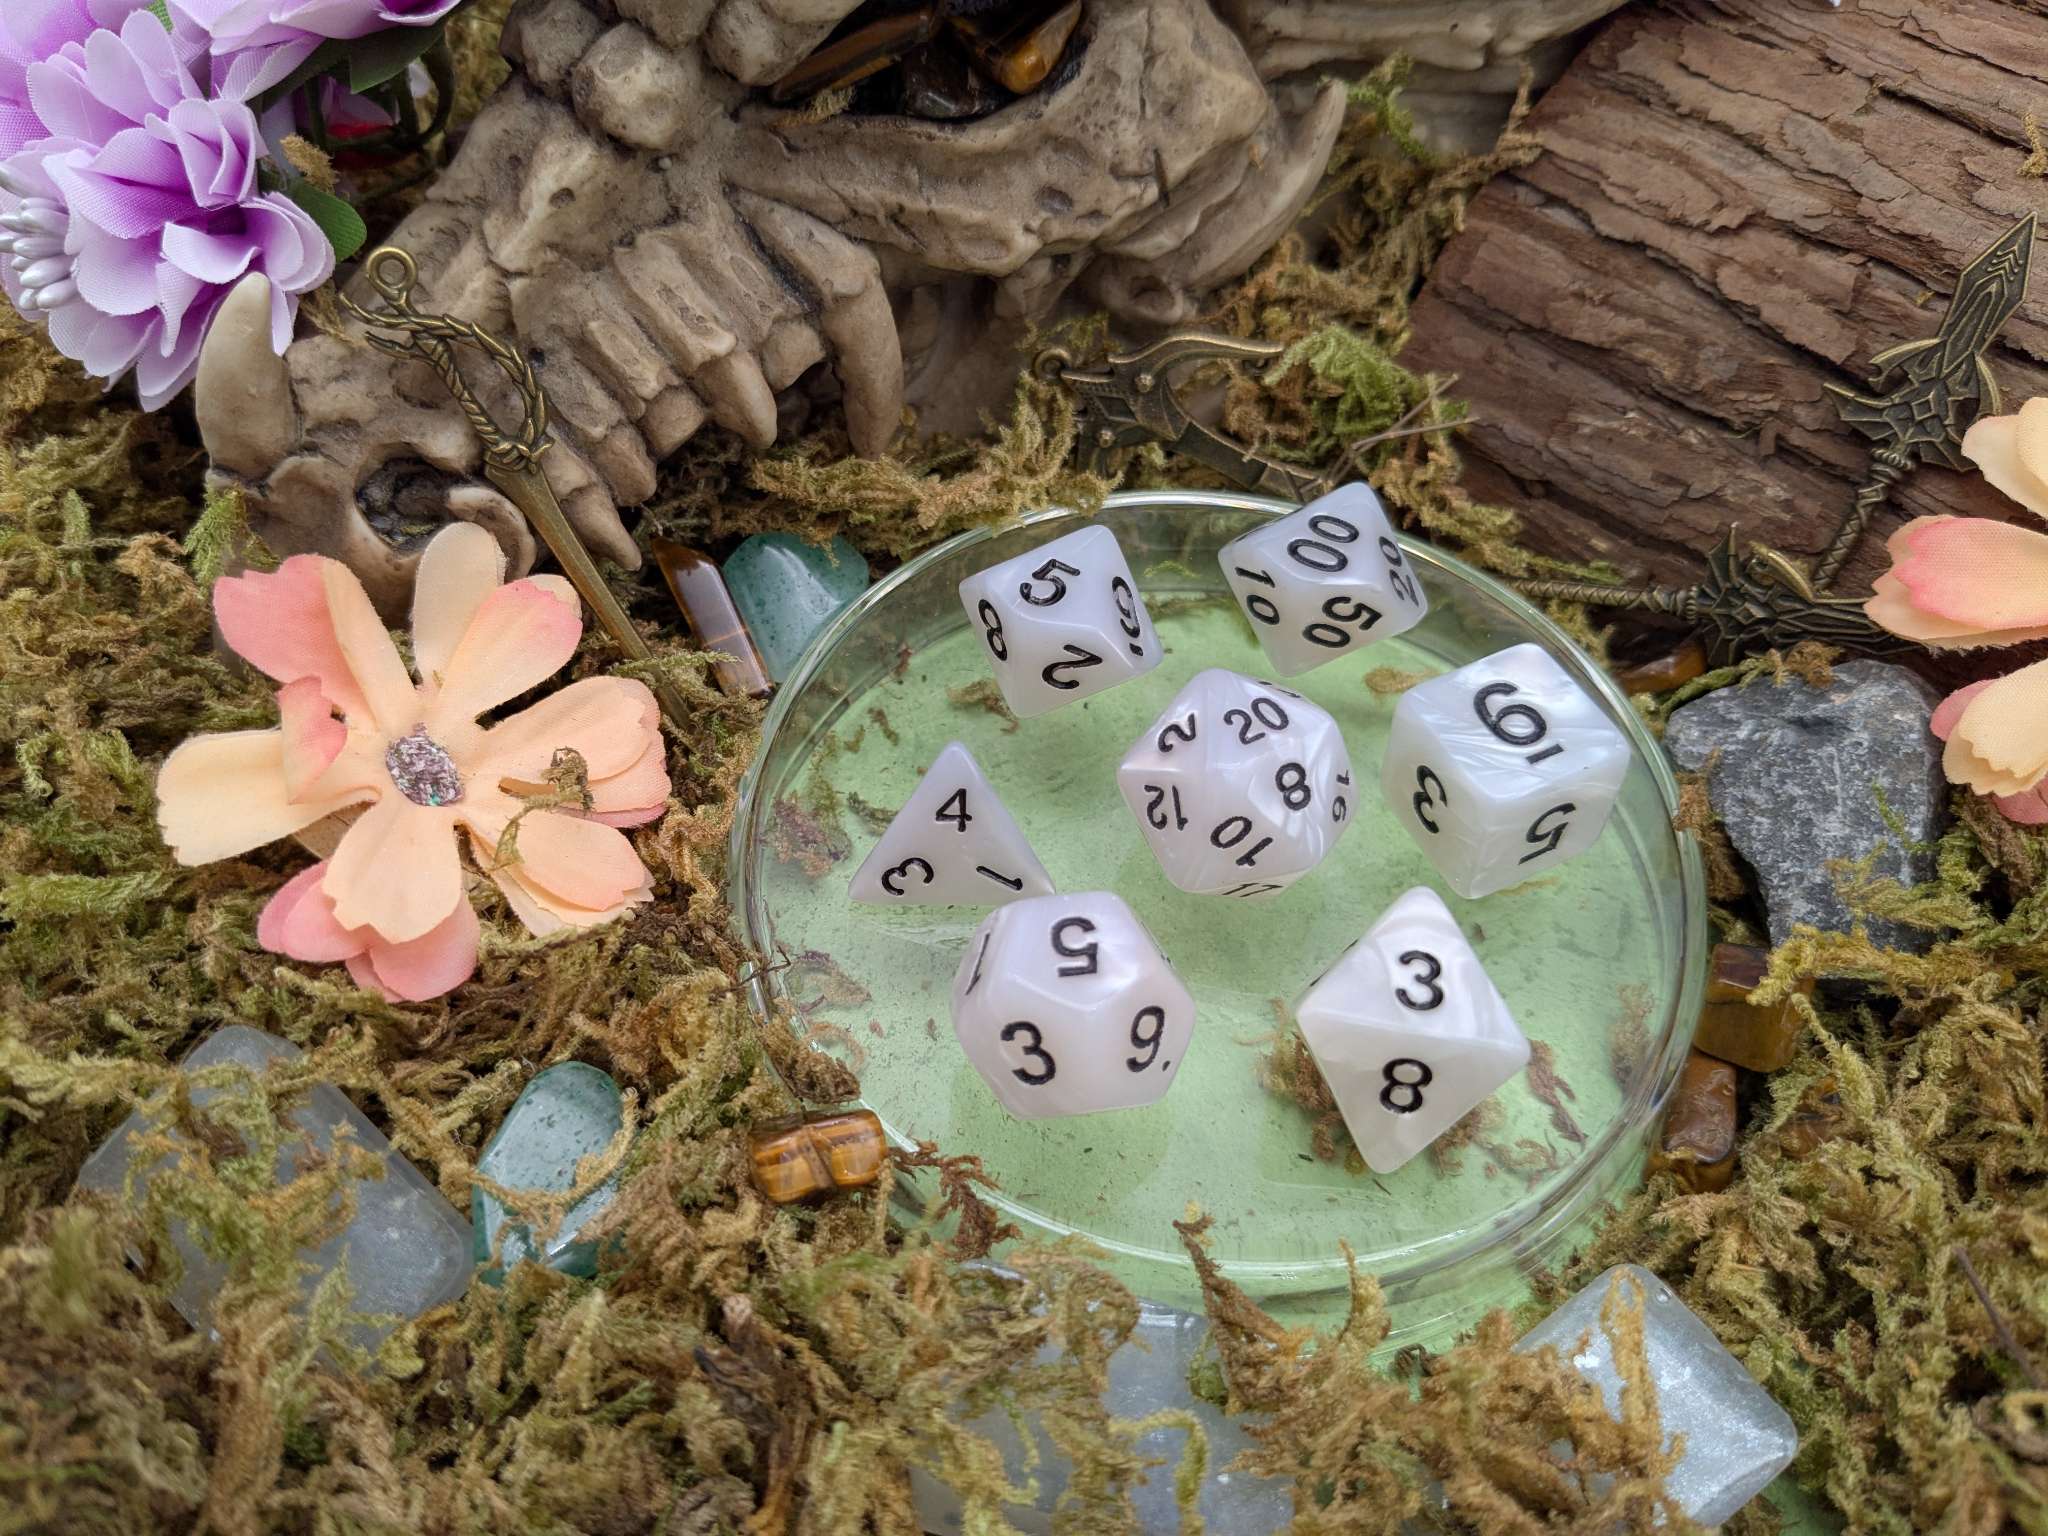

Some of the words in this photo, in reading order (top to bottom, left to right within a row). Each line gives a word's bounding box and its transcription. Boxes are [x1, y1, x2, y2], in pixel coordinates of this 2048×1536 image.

[1287, 515, 1360, 573] 00
[1019, 558, 1081, 607] 5
[1235, 566, 1281, 626] 10
[978, 599, 1008, 662] 8
[1302, 595, 1383, 649] 50
[1041, 644, 1103, 690] 2
[1158, 713, 1197, 753] 2
[1223, 697, 1290, 746] 20
[935, 788, 973, 833] 4
[1144, 784, 1190, 831] 12
[1275, 762, 1312, 811] 8
[1413, 764, 1448, 835] 3
[1210, 816, 1274, 867] 10
[1518, 802, 1577, 865] 5
[881, 857, 934, 896] 3
[976, 865, 1024, 891] 1
[1050, 916, 1099, 978] 5
[1395, 950, 1444, 1011] 3
[1000, 1020, 1057, 1086] 3
[1379, 1057, 1433, 1114] 8
